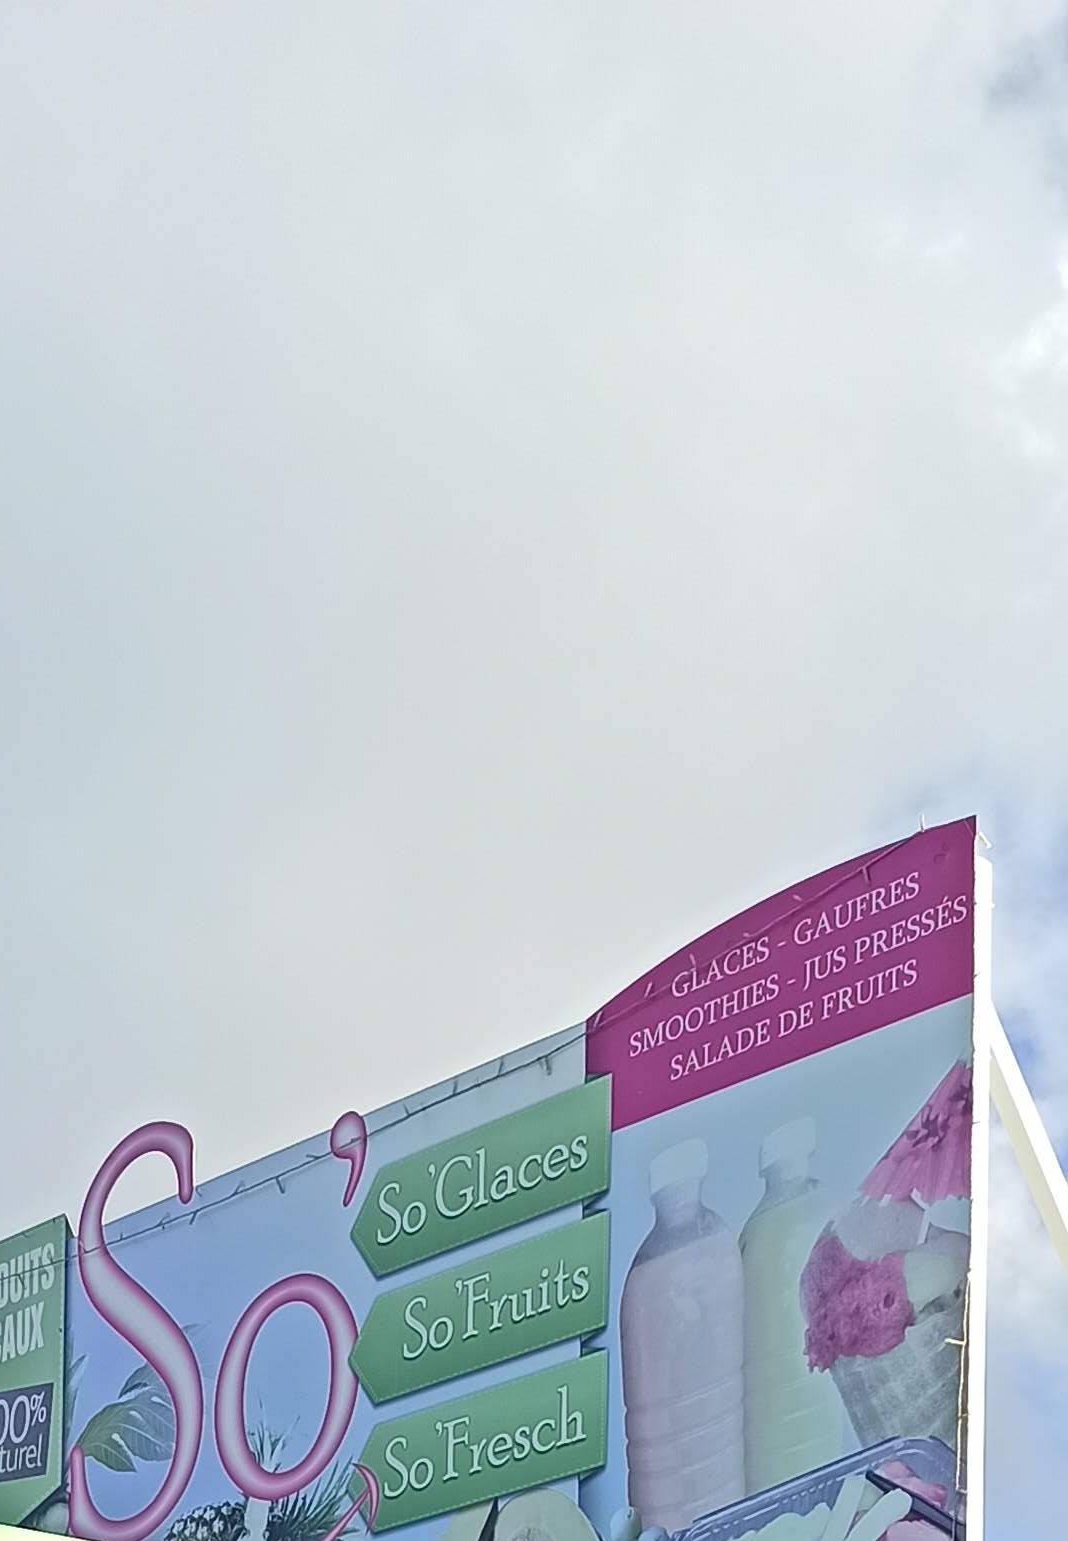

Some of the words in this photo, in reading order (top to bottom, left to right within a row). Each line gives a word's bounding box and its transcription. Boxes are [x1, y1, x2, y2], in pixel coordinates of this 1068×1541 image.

[629, 973, 780, 1058] SMOOTHIES
[801, 946, 847, 992] JUS
[854, 894, 969, 965] PRESSÉS
[671, 936, 770, 998] GLACES
[793, 871, 921, 946] GAUFRES
[669, 1018, 771, 1082] SALADE
[777, 1002, 814, 1039] DE
[821, 958, 919, 1022] FRUITS
